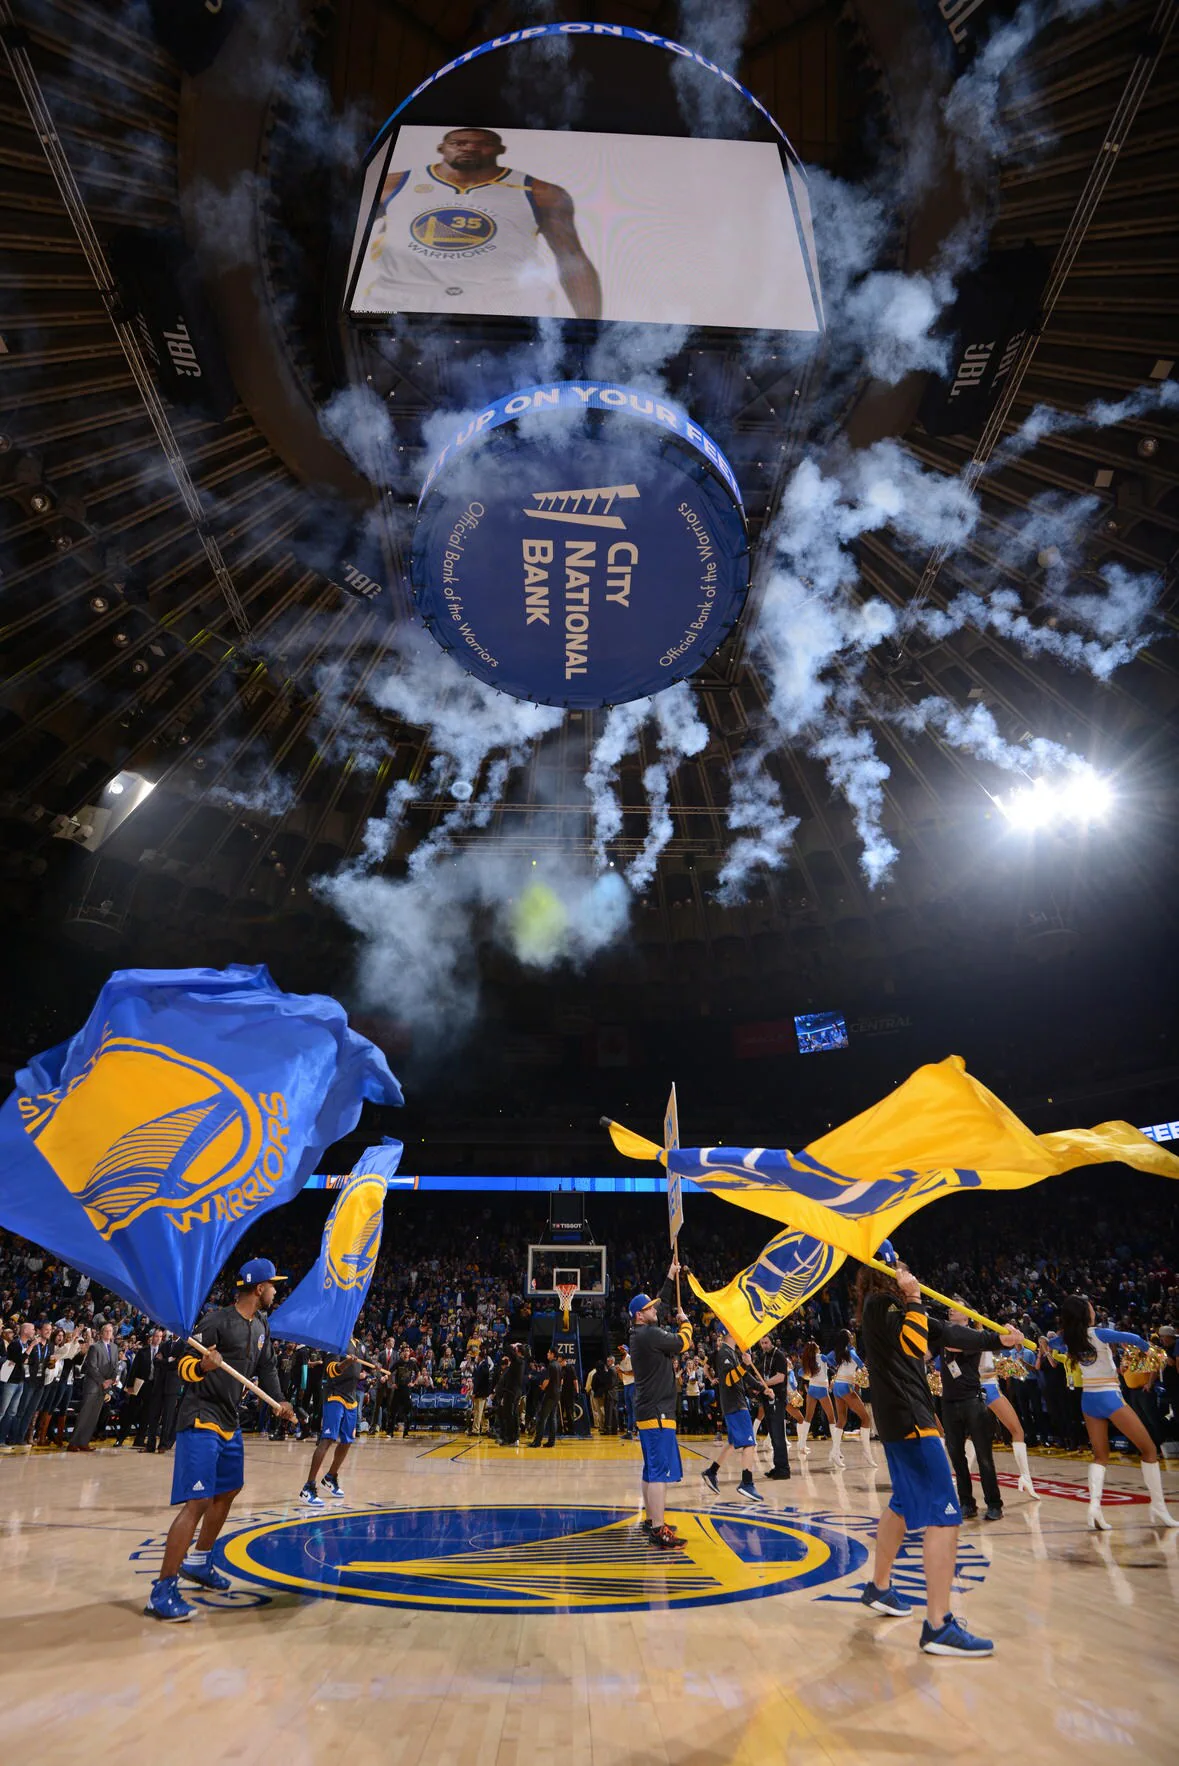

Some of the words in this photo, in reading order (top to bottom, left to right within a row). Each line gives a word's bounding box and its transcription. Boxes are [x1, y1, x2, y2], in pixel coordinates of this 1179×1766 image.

[411, 46, 482, 97] GET
[492, 27, 548, 49] UP
[559, 23, 623, 35] ON
[635, 31, 745, 94] YOUR
[451, 216, 482, 229] 35
[408, 241, 498, 260] WARRIORS
[162, 323, 203, 378] JBL
[950, 340, 997, 396] JBL
[456, 409, 496, 447] UP
[504, 387, 561, 416] ON
[570, 386, 680, 430] YOUR
[685, 421, 743, 504] FEET
[448, 501, 486, 552] Official
[678, 501, 715, 562] Warriors
[344, 563, 384, 600] JBL
[443, 550, 461, 584] Bank
[522, 538, 554, 627] BANK
[605, 541, 640, 609] CITY
[701, 561, 718, 583] the
[443, 587, 462, 601] of
[448, 603, 465, 621] the
[563, 539, 597, 681] NATIONAL
[700, 585, 717, 598] of
[690, 600, 715, 631] Bank
[458, 622, 500, 669] Warriors
[659, 630, 699, 667] Official
[163, 1091, 291, 1234] WARRIORS
[557, 1343, 575, 1354] ZTE
